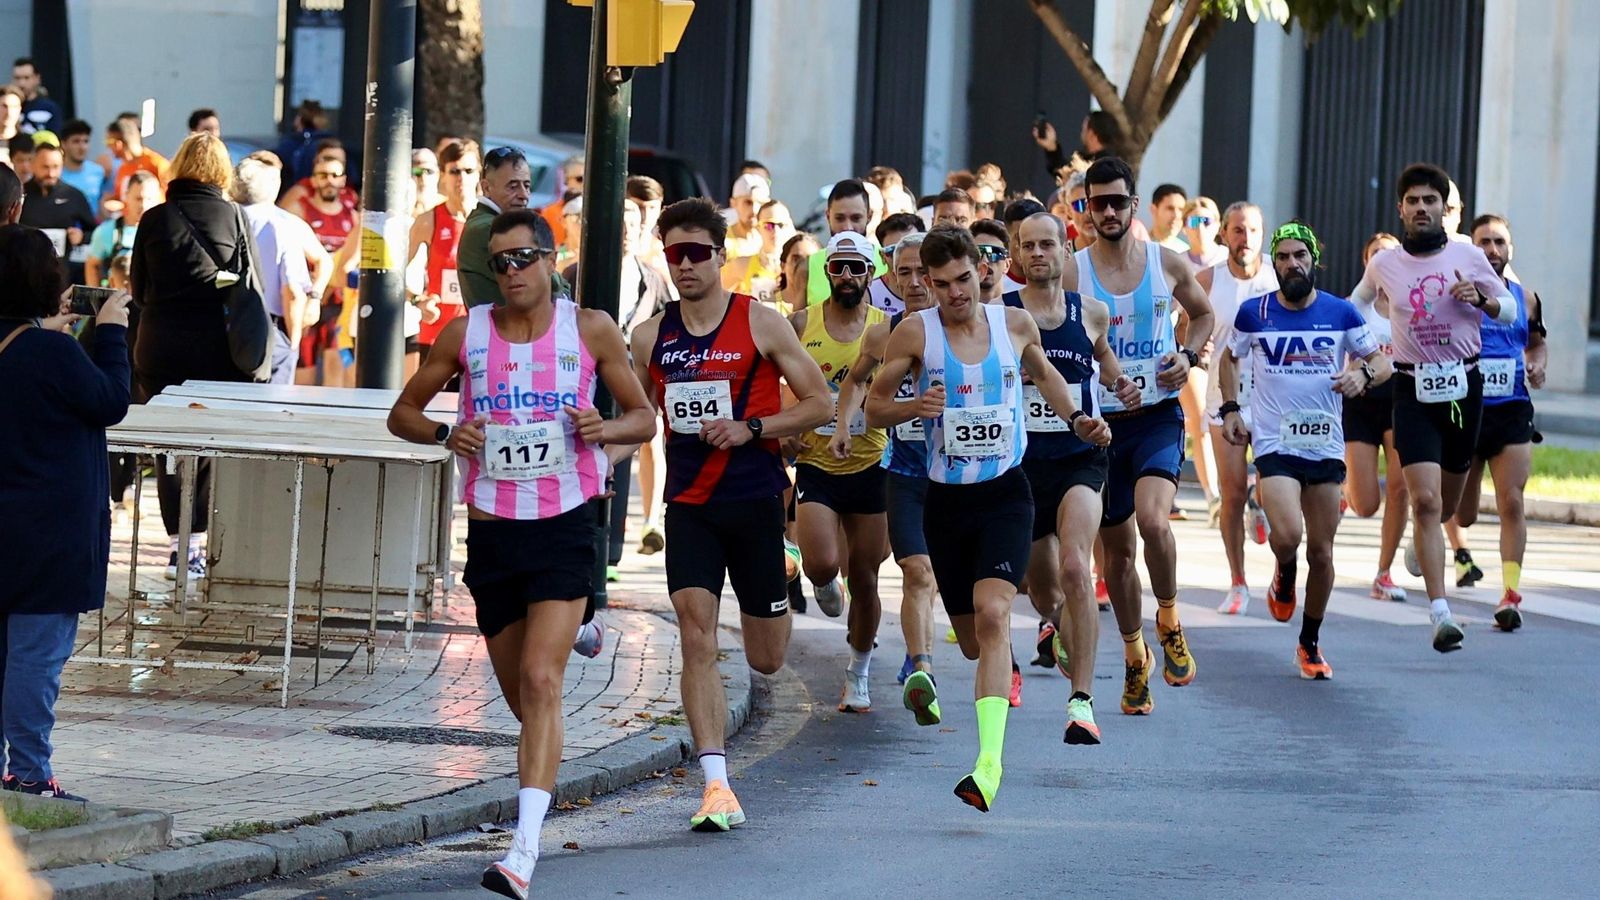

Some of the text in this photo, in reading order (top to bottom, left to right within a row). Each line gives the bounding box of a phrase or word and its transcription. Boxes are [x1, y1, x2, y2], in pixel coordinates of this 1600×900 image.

[661, 348, 742, 365] RFC Liège
[1258, 336, 1335, 366] VAS
[928, 367, 944, 375] vive
[1422, 375, 1459, 391] 324
[674, 400, 719, 418] 694
[956, 424, 1002, 441] 330
[1289, 423, 1330, 435] 1029
[498, 443, 549, 464] 117
